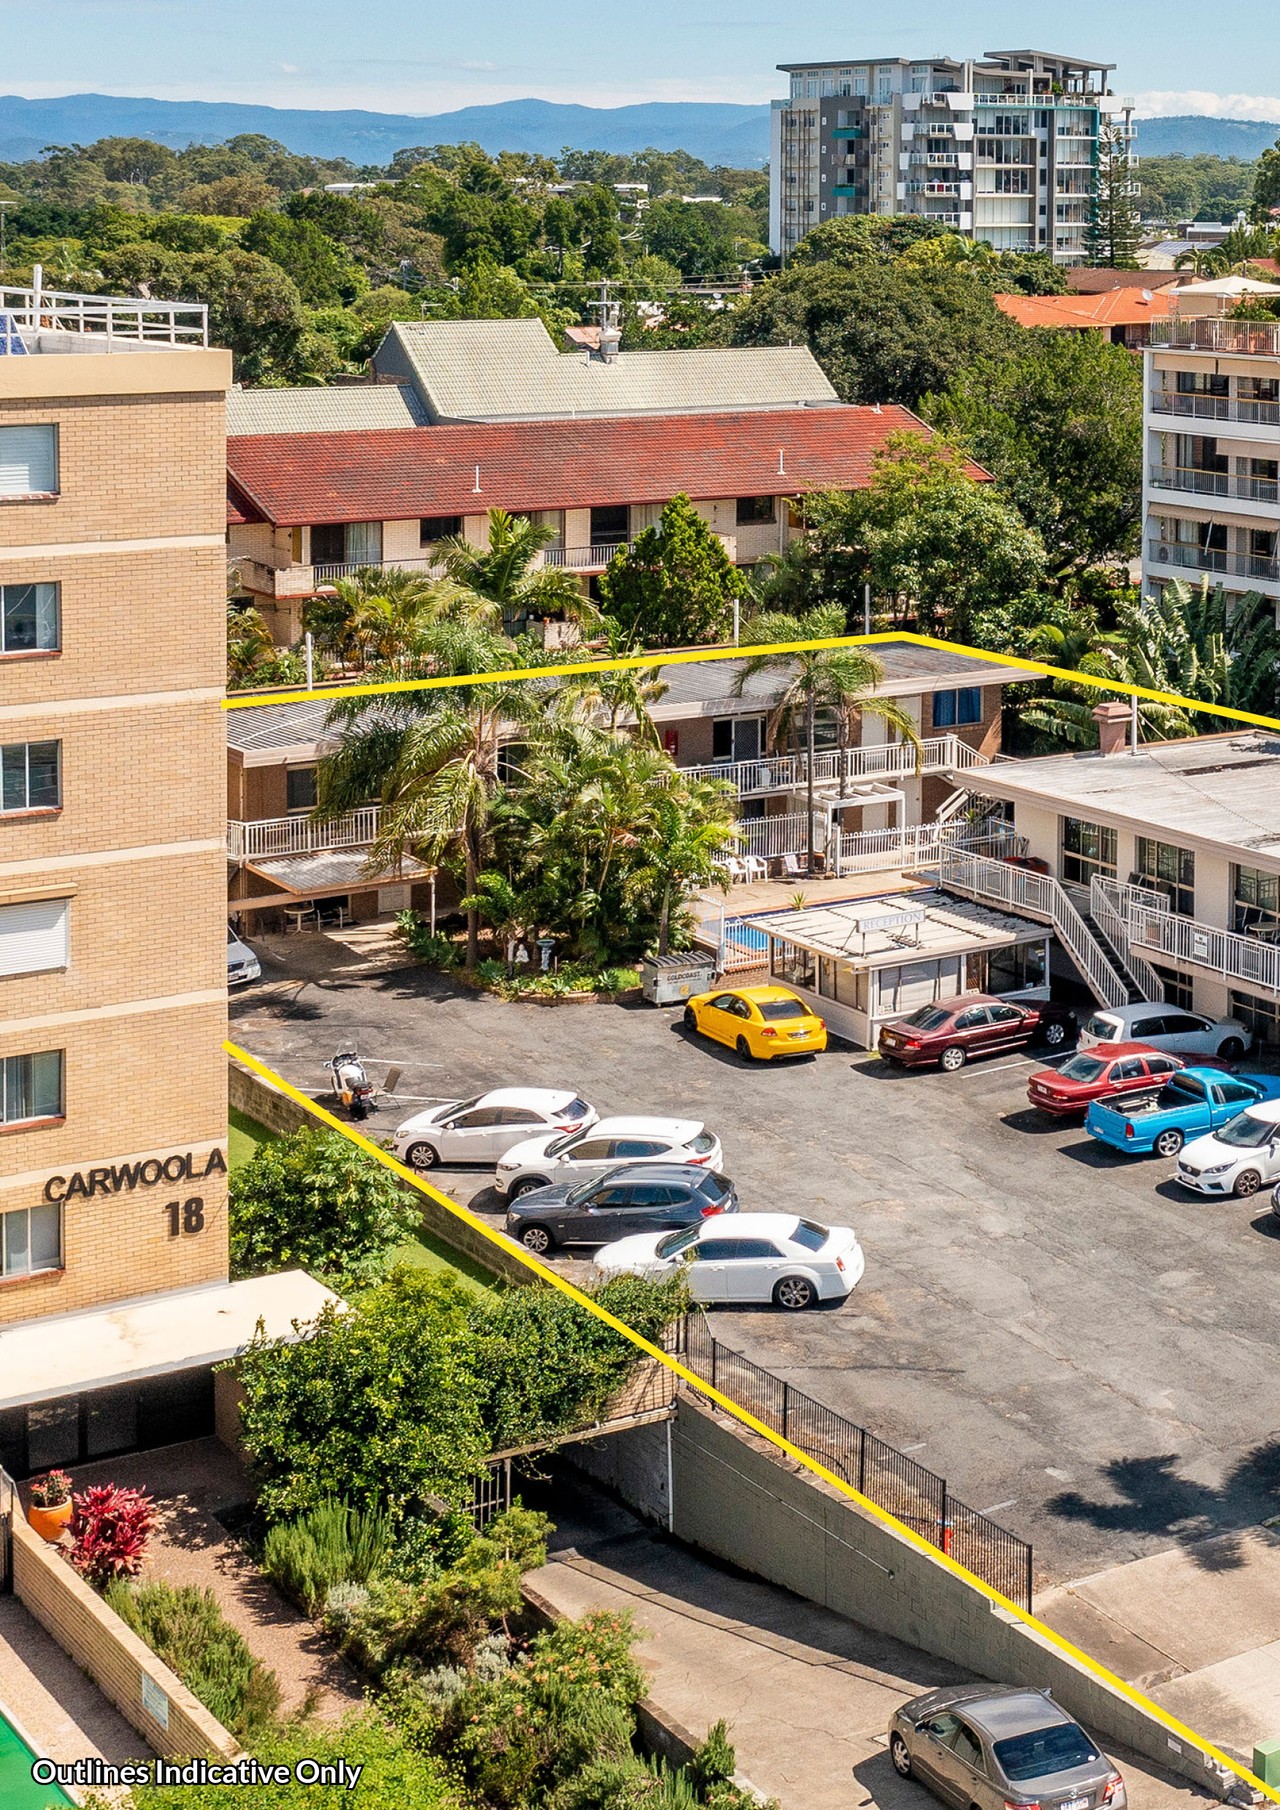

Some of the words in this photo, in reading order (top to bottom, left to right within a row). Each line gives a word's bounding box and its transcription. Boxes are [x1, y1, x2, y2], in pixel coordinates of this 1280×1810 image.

[863, 912, 921, 930] RECEPTION
[44, 1147, 228, 1203] CARWOOLA
[164, 1196, 205, 1237] 18
